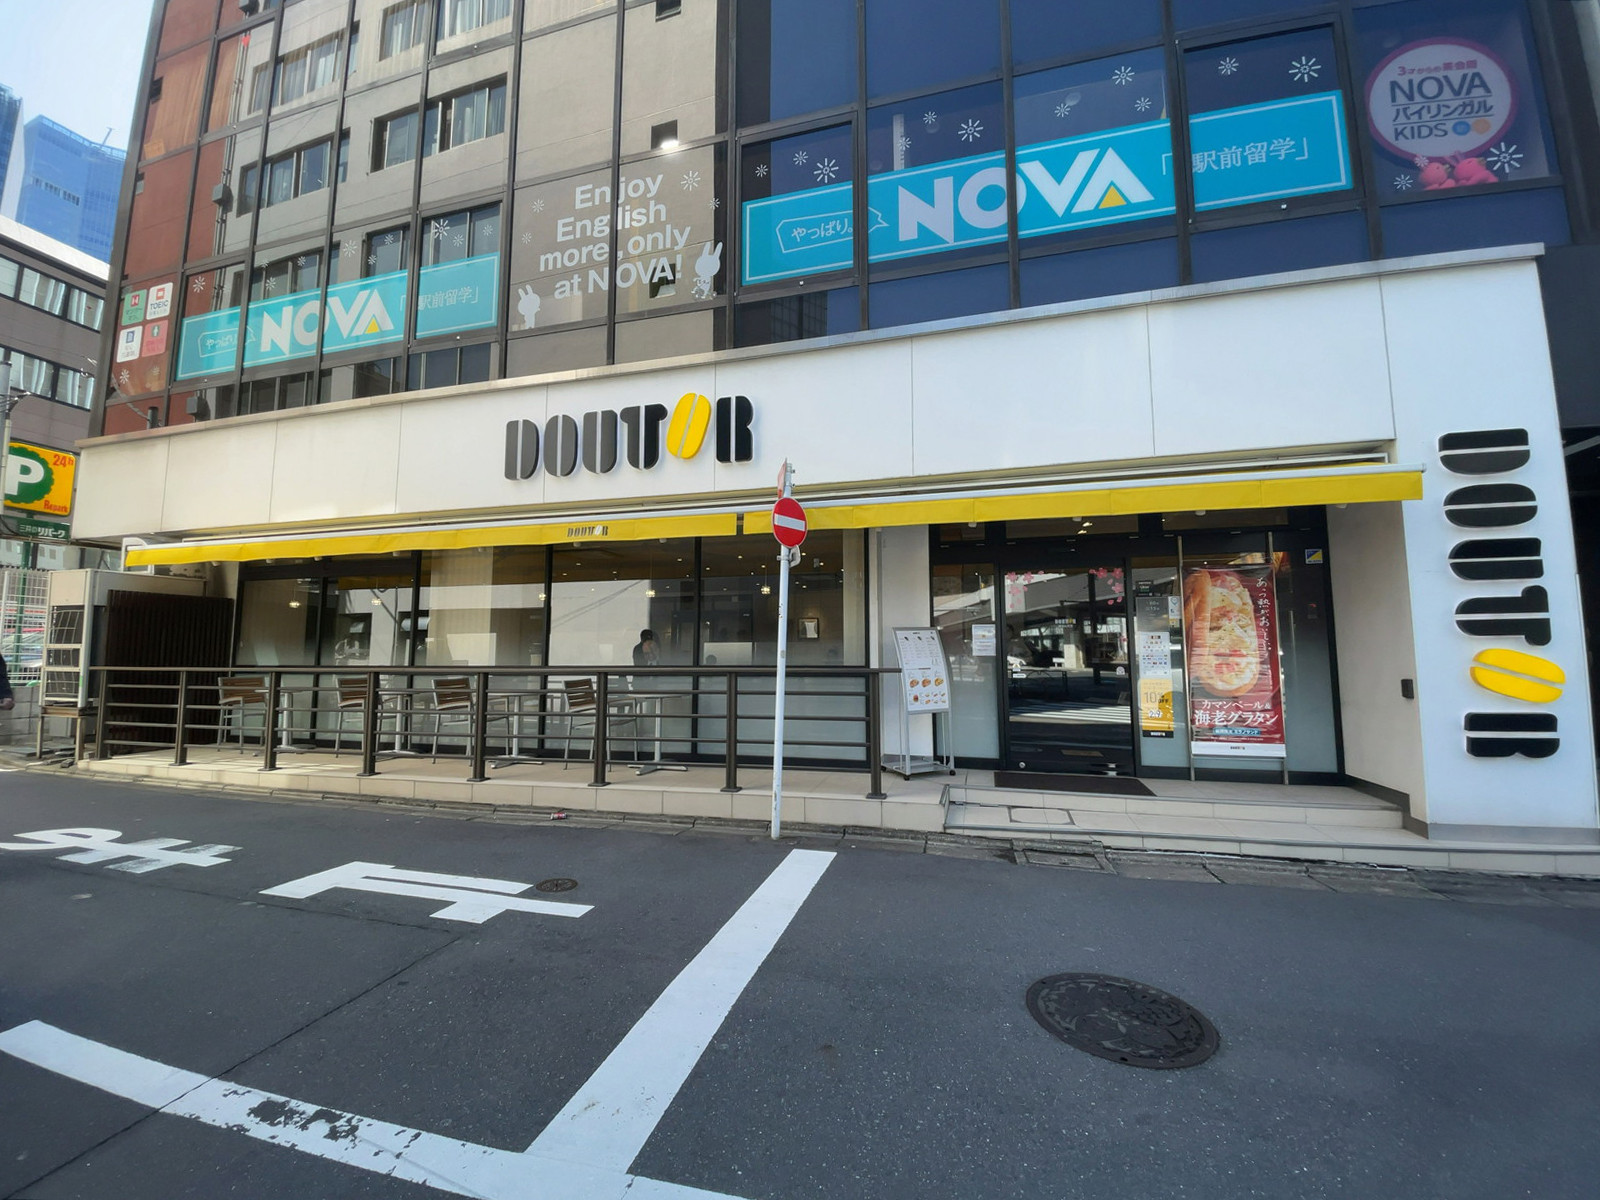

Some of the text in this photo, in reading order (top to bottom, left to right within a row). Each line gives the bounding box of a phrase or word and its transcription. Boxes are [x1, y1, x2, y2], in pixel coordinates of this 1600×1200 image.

[1389, 72, 1492, 103] NOVA
[1393, 100, 1493, 122] バイリンガル
[1394, 123, 1448, 141] KIDS
[574, 174, 663, 209] Enjoy
[897, 146, 1153, 245] NOVA
[556, 200, 667, 241] English
[539, 225, 691, 272] more, only
[554, 254, 683, 301] at NOVA!
[150, 300, 169, 310] TOEIC
[261, 289, 394, 356] NOVA
[504, 392, 754, 481] DOUTOR
[5, 454, 45, 495] P
[53, 454, 74, 468] 24h
[43, 500, 68, 513] Repark
[20, 525, 65, 537] 三井のリパーク
[567, 525, 609, 537] DOUTOR
[1438, 428, 1566, 759] DOUTOR
[1194, 710, 1279, 726] 海老グラタン
